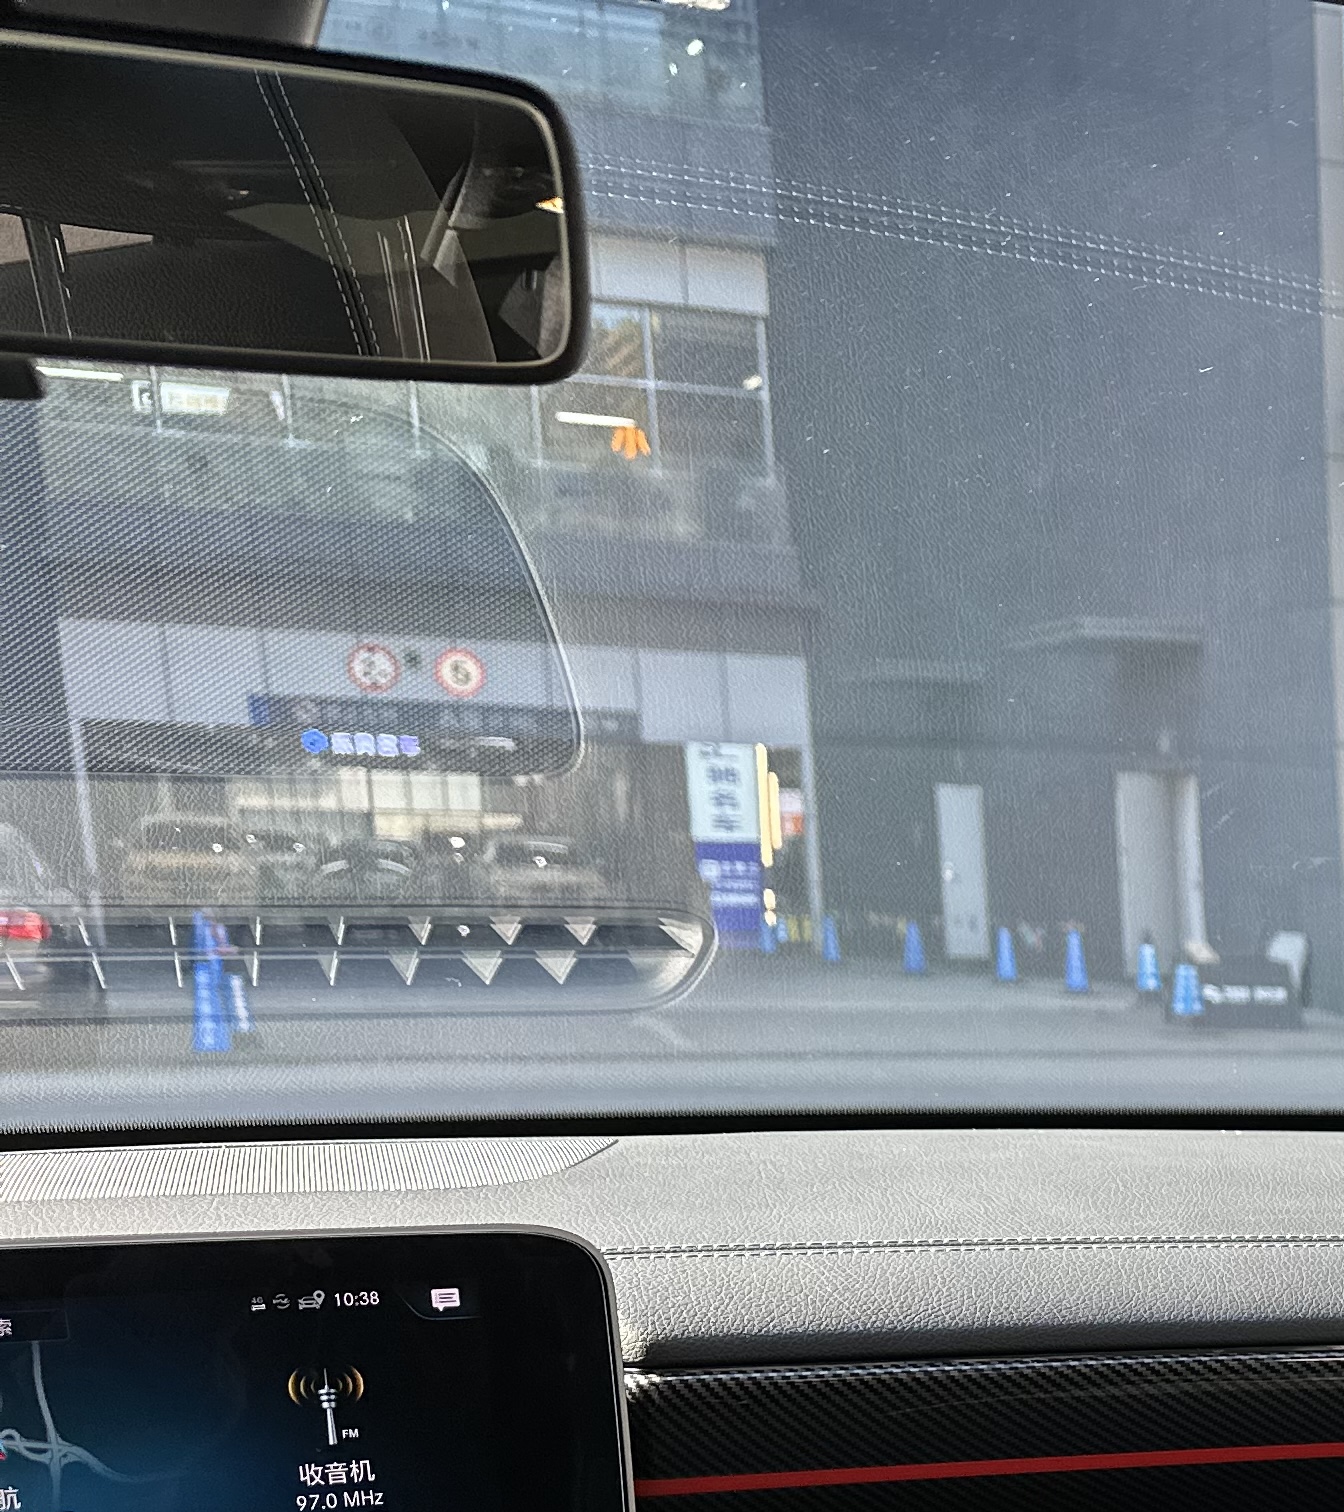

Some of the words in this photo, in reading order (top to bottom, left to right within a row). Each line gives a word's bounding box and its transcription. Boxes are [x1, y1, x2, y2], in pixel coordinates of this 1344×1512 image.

[334, 1290, 380, 1307] 10:38
[342, 1428, 359, 1439] FM
[299, 1459, 376, 1487] 收音机
[296, 1492, 338, 1511] 97.0
[343, 1490, 384, 1508] MHz
